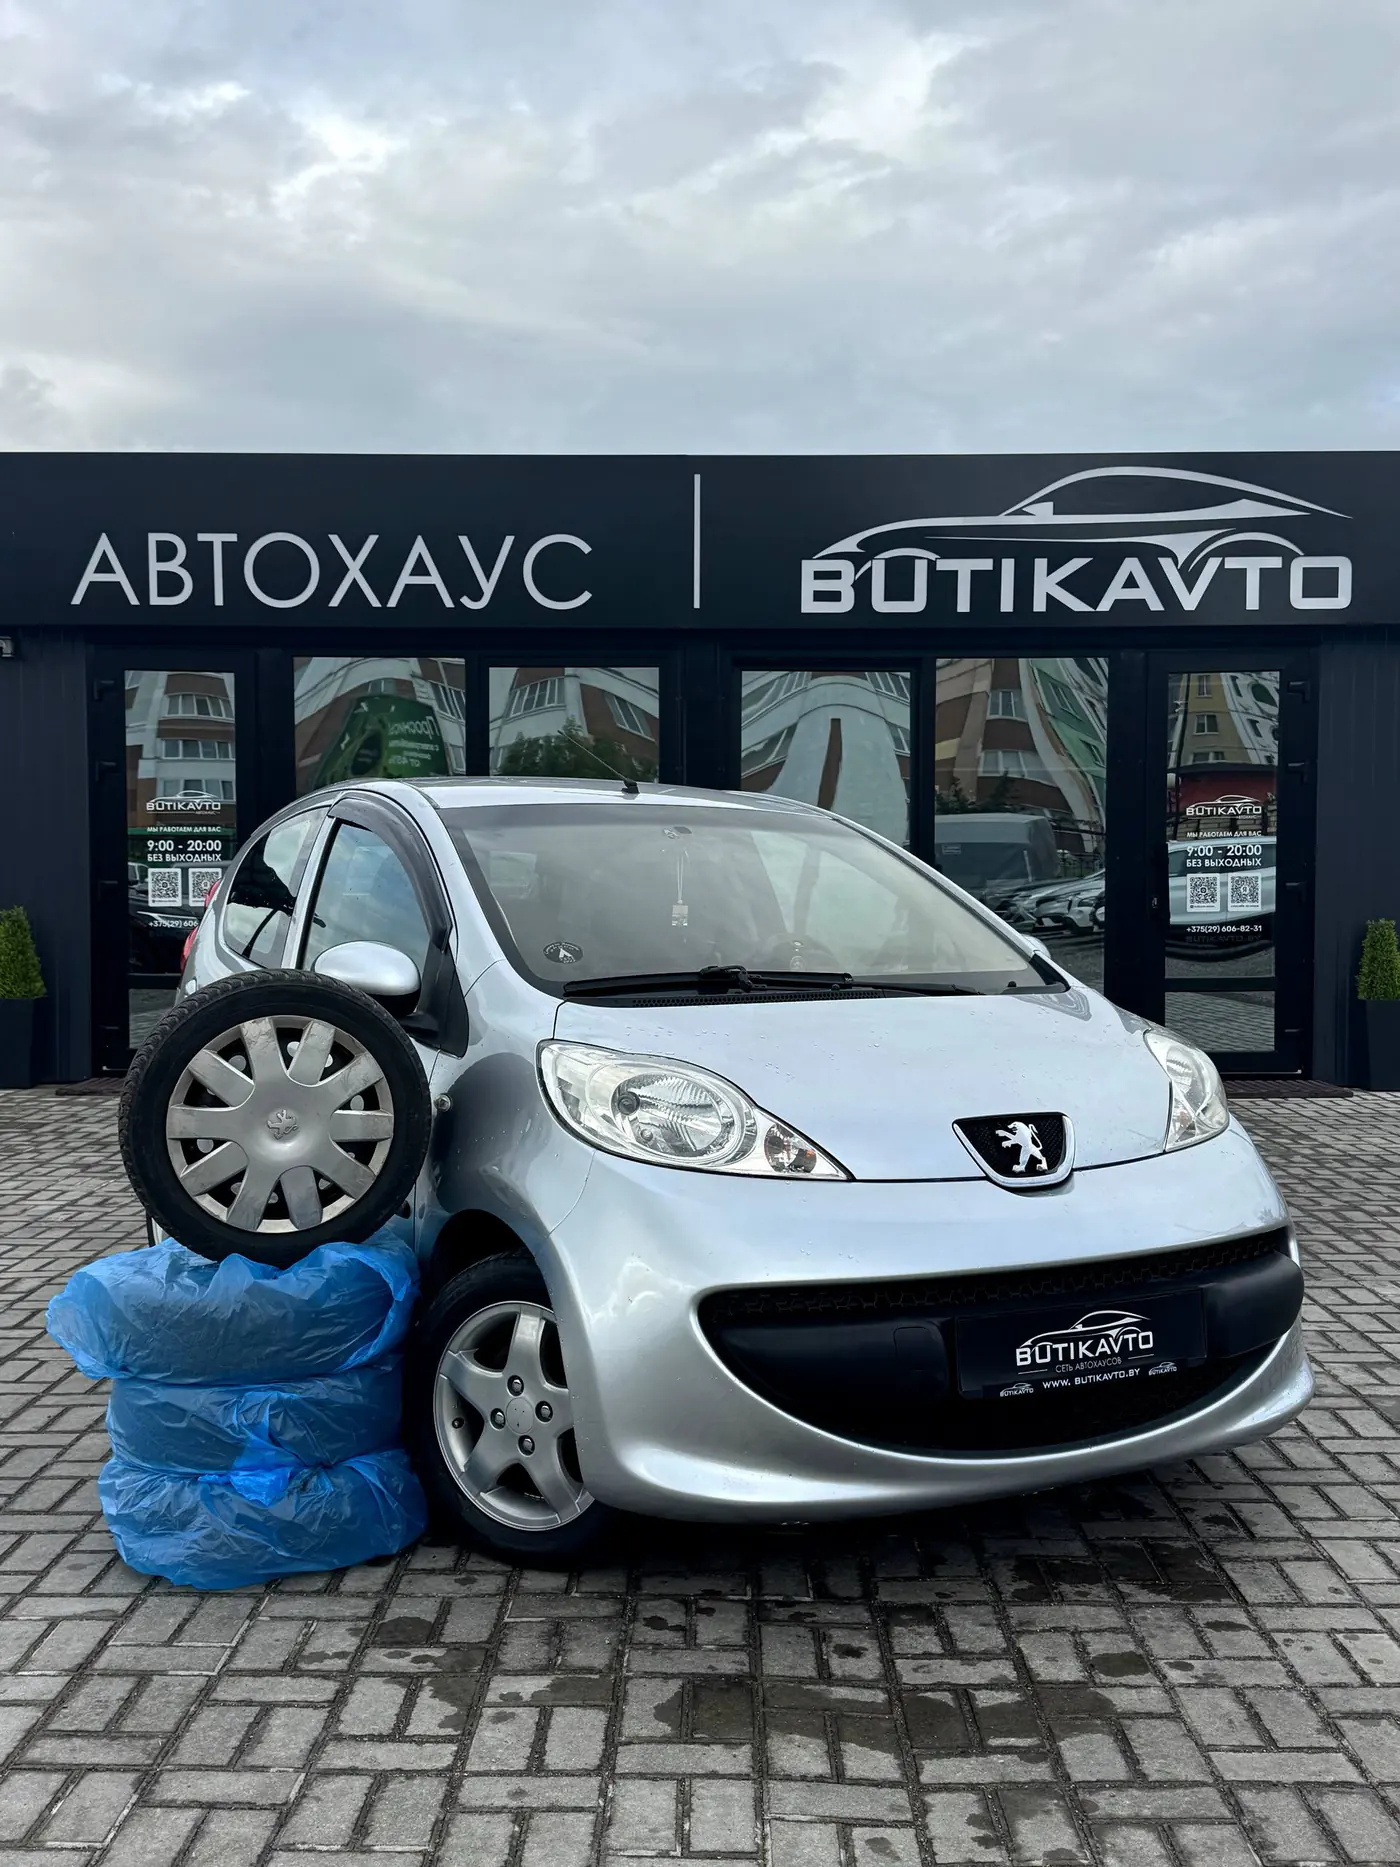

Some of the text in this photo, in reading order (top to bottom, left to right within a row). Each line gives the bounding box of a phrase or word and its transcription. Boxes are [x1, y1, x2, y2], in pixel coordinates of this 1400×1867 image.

[71, 531, 593, 610] АВТОХАУС
[801, 556, 1353, 614] BUTIKAVTO
[146, 802, 221, 811] BUTIKAVTO
[1186, 806, 1262, 816] BUTIKAVTO
[147, 840, 174, 851] 9:00
[187, 840, 222, 851] 20:00
[1186, 845, 1213, 857] 9:00
[1227, 844, 1262, 856] 20:00
[147, 853, 222, 863] БЕЗ ВЫХОДНЫХ
[1186, 858, 1262, 867] БЕЗ ВЫХОДНЫХ
[1186, 925, 1220, 933] +375(29)
[1016, 1331, 1154, 1366] BUTIKAVTO
[1055, 1356, 1122, 1374] СЕТЬ АВТОХАУСОВ
[1148, 1366, 1177, 1376] BUTIKAVTO
[1042, 1368, 1141, 1389] WWW. BUTIKAVTO.BY
[1000, 1387, 1034, 1397] BUTIKAVTO
